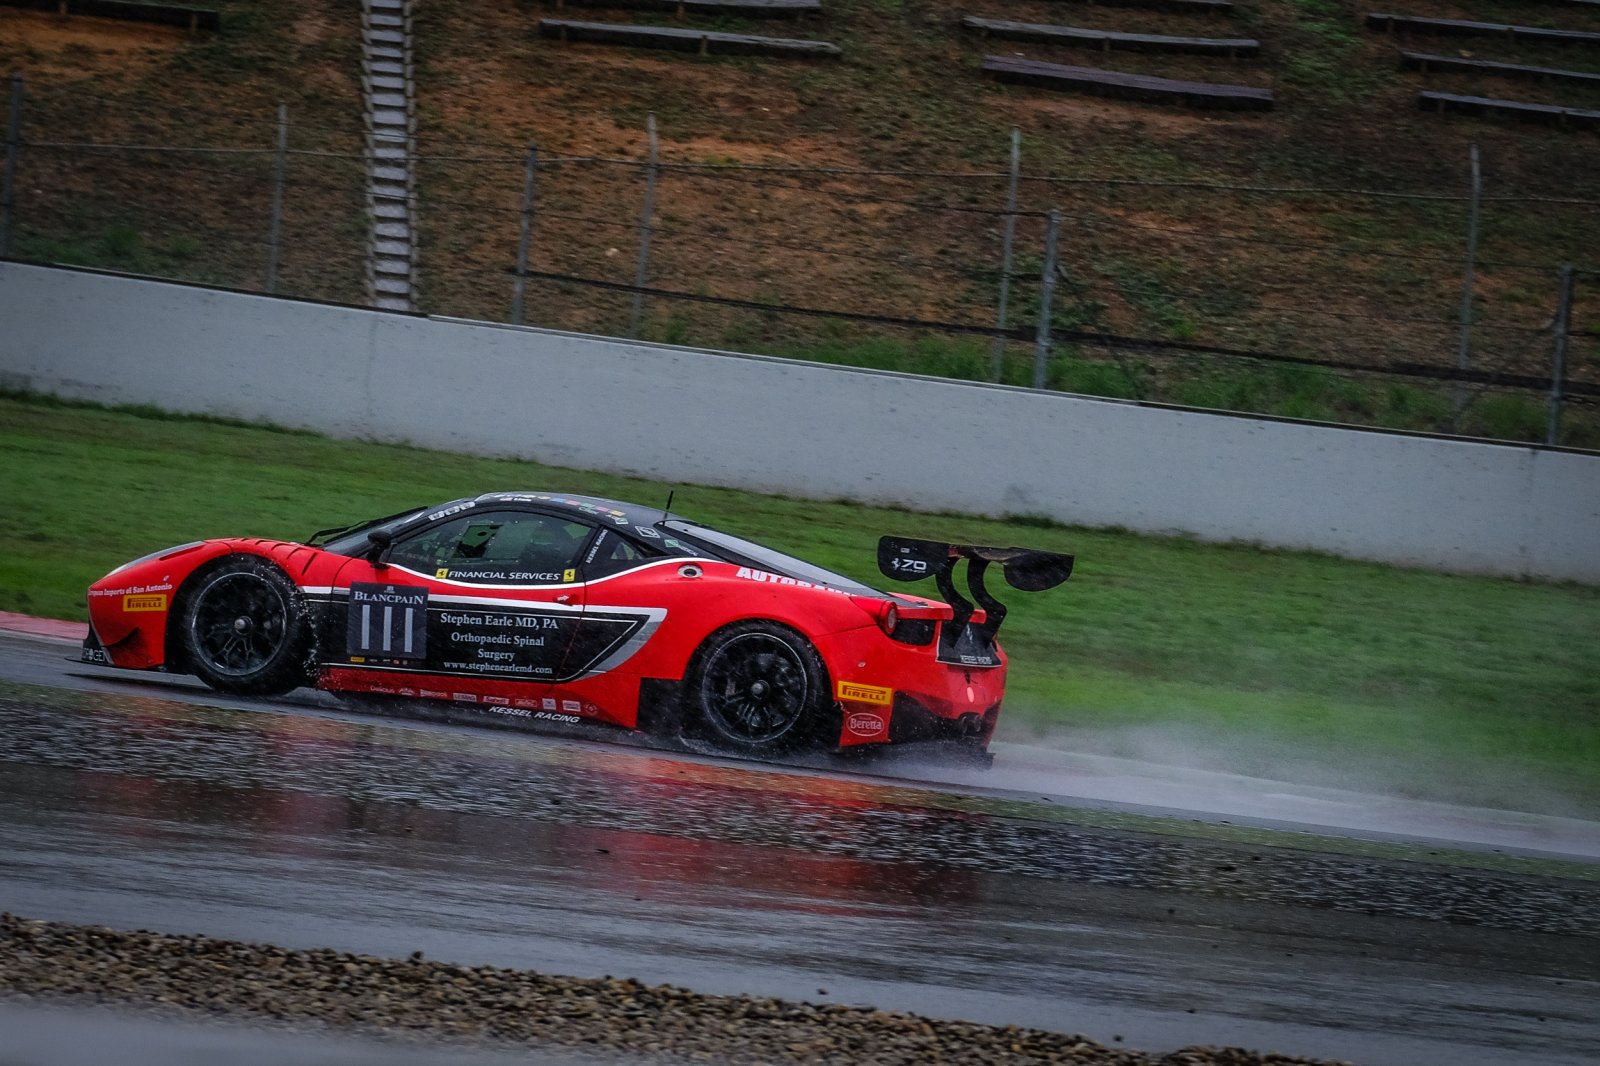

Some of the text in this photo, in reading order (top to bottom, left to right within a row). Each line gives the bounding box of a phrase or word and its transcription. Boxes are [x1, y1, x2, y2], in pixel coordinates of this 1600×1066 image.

[901, 559, 927, 570] 70
[448, 571, 560, 580] FINANCIAL SERVICES
[145, 583, 173, 592] Antonio
[127, 598, 162, 608] PIRELLI
[354, 591, 424, 604] BLANCPAIN
[440, 612, 559, 630] Stephen Earle MD, PA
[451, 632, 545, 647] Orthopaedic Spinal
[478, 648, 516, 661] Surgery
[842, 685, 886, 701] PIRELLI
[488, 706, 581, 723] KESSEL RACING
[850, 718, 882, 730] Beretta
